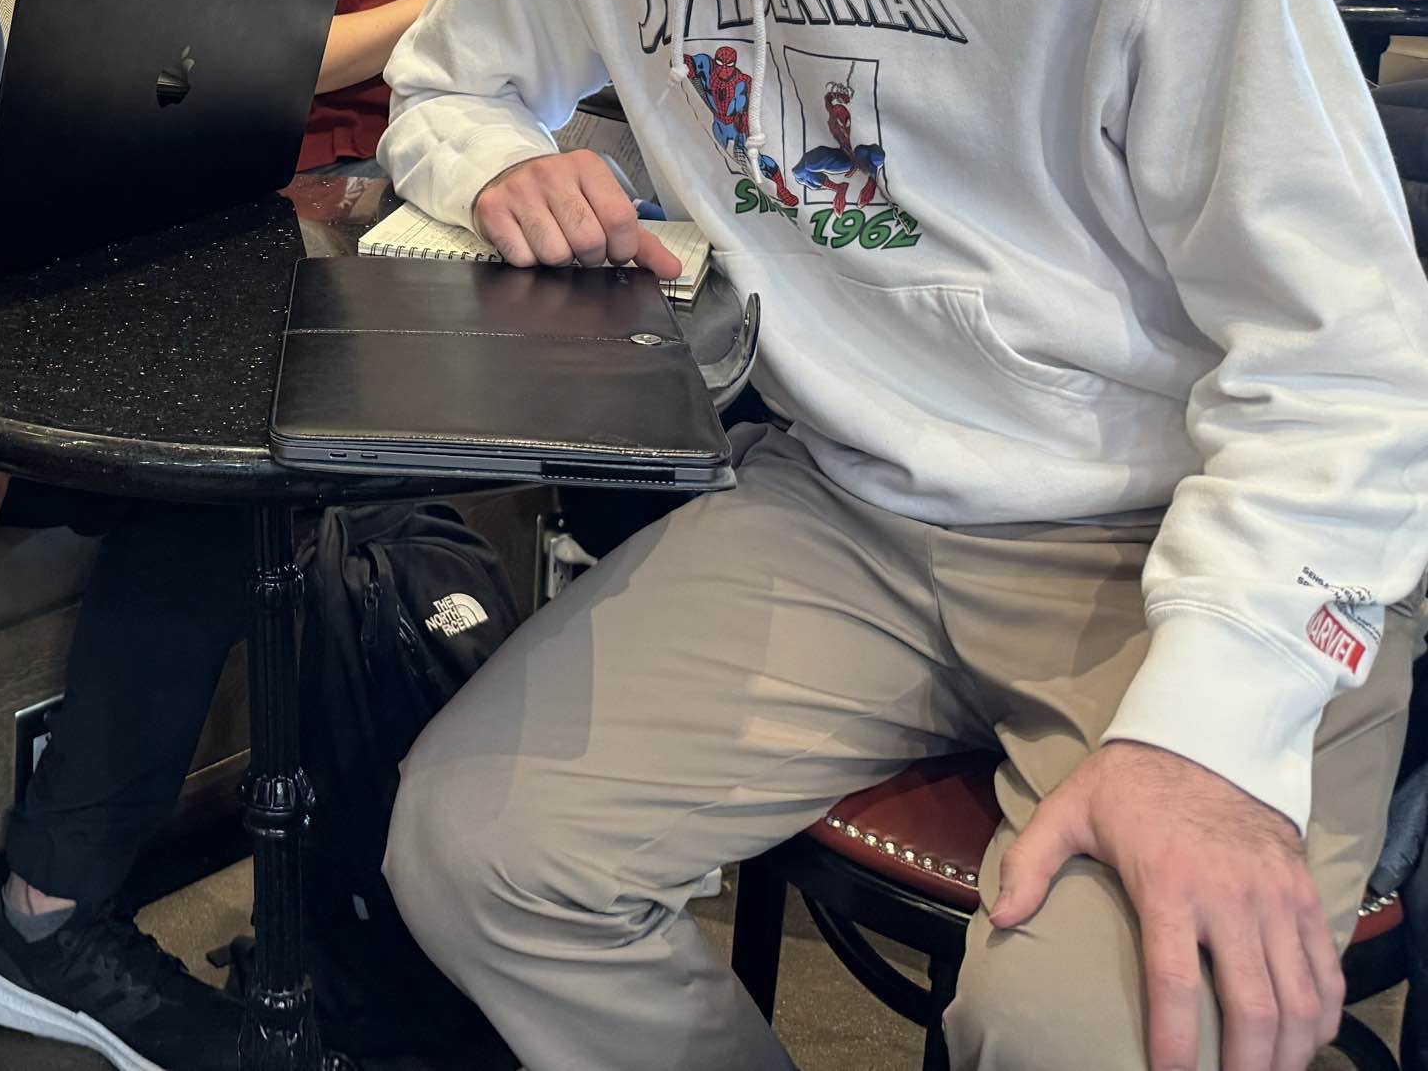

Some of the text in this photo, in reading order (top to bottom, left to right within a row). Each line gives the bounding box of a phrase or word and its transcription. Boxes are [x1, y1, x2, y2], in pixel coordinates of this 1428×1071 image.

[811, 208, 923, 250] 1962
[433, 596, 454, 612] THE
[425, 607, 460, 633] NORTH
